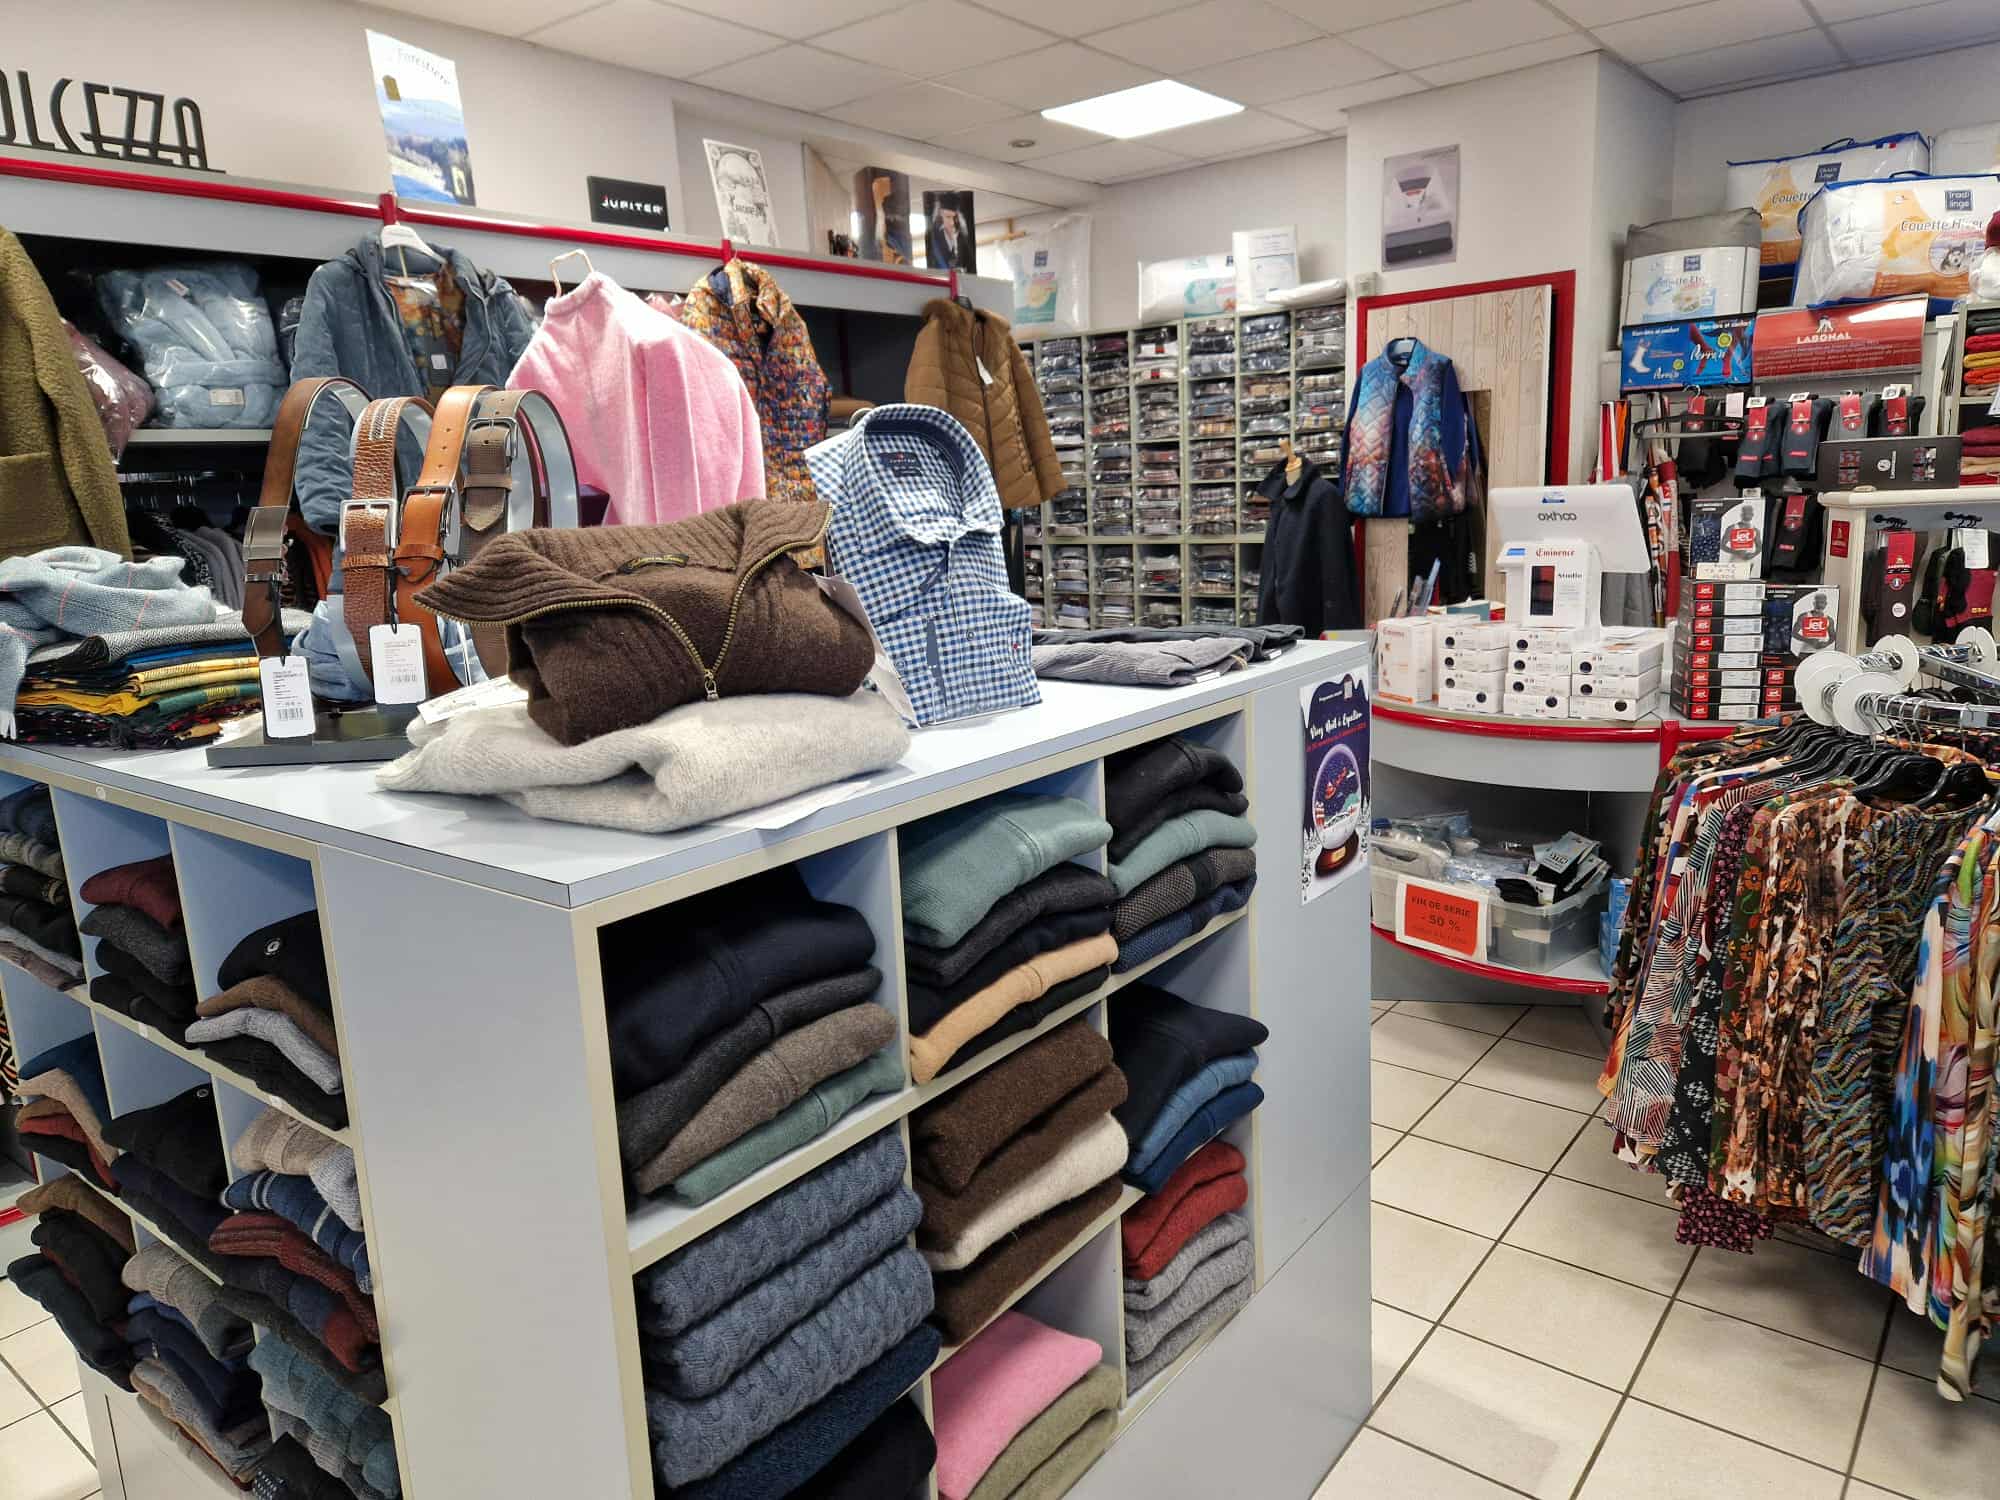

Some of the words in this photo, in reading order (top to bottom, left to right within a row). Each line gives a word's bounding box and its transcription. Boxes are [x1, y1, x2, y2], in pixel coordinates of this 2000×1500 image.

[602, 195, 663, 215] JUPITER
[1900, 219, 1950, 232] Couette
[1796, 332, 1853, 345] LABONAL
[1535, 548, 1576, 557] Eminence
[1428, 900, 1441, 910] DE
[1429, 914, 1445, 927] 50
[1448, 919, 1461, 932] %
